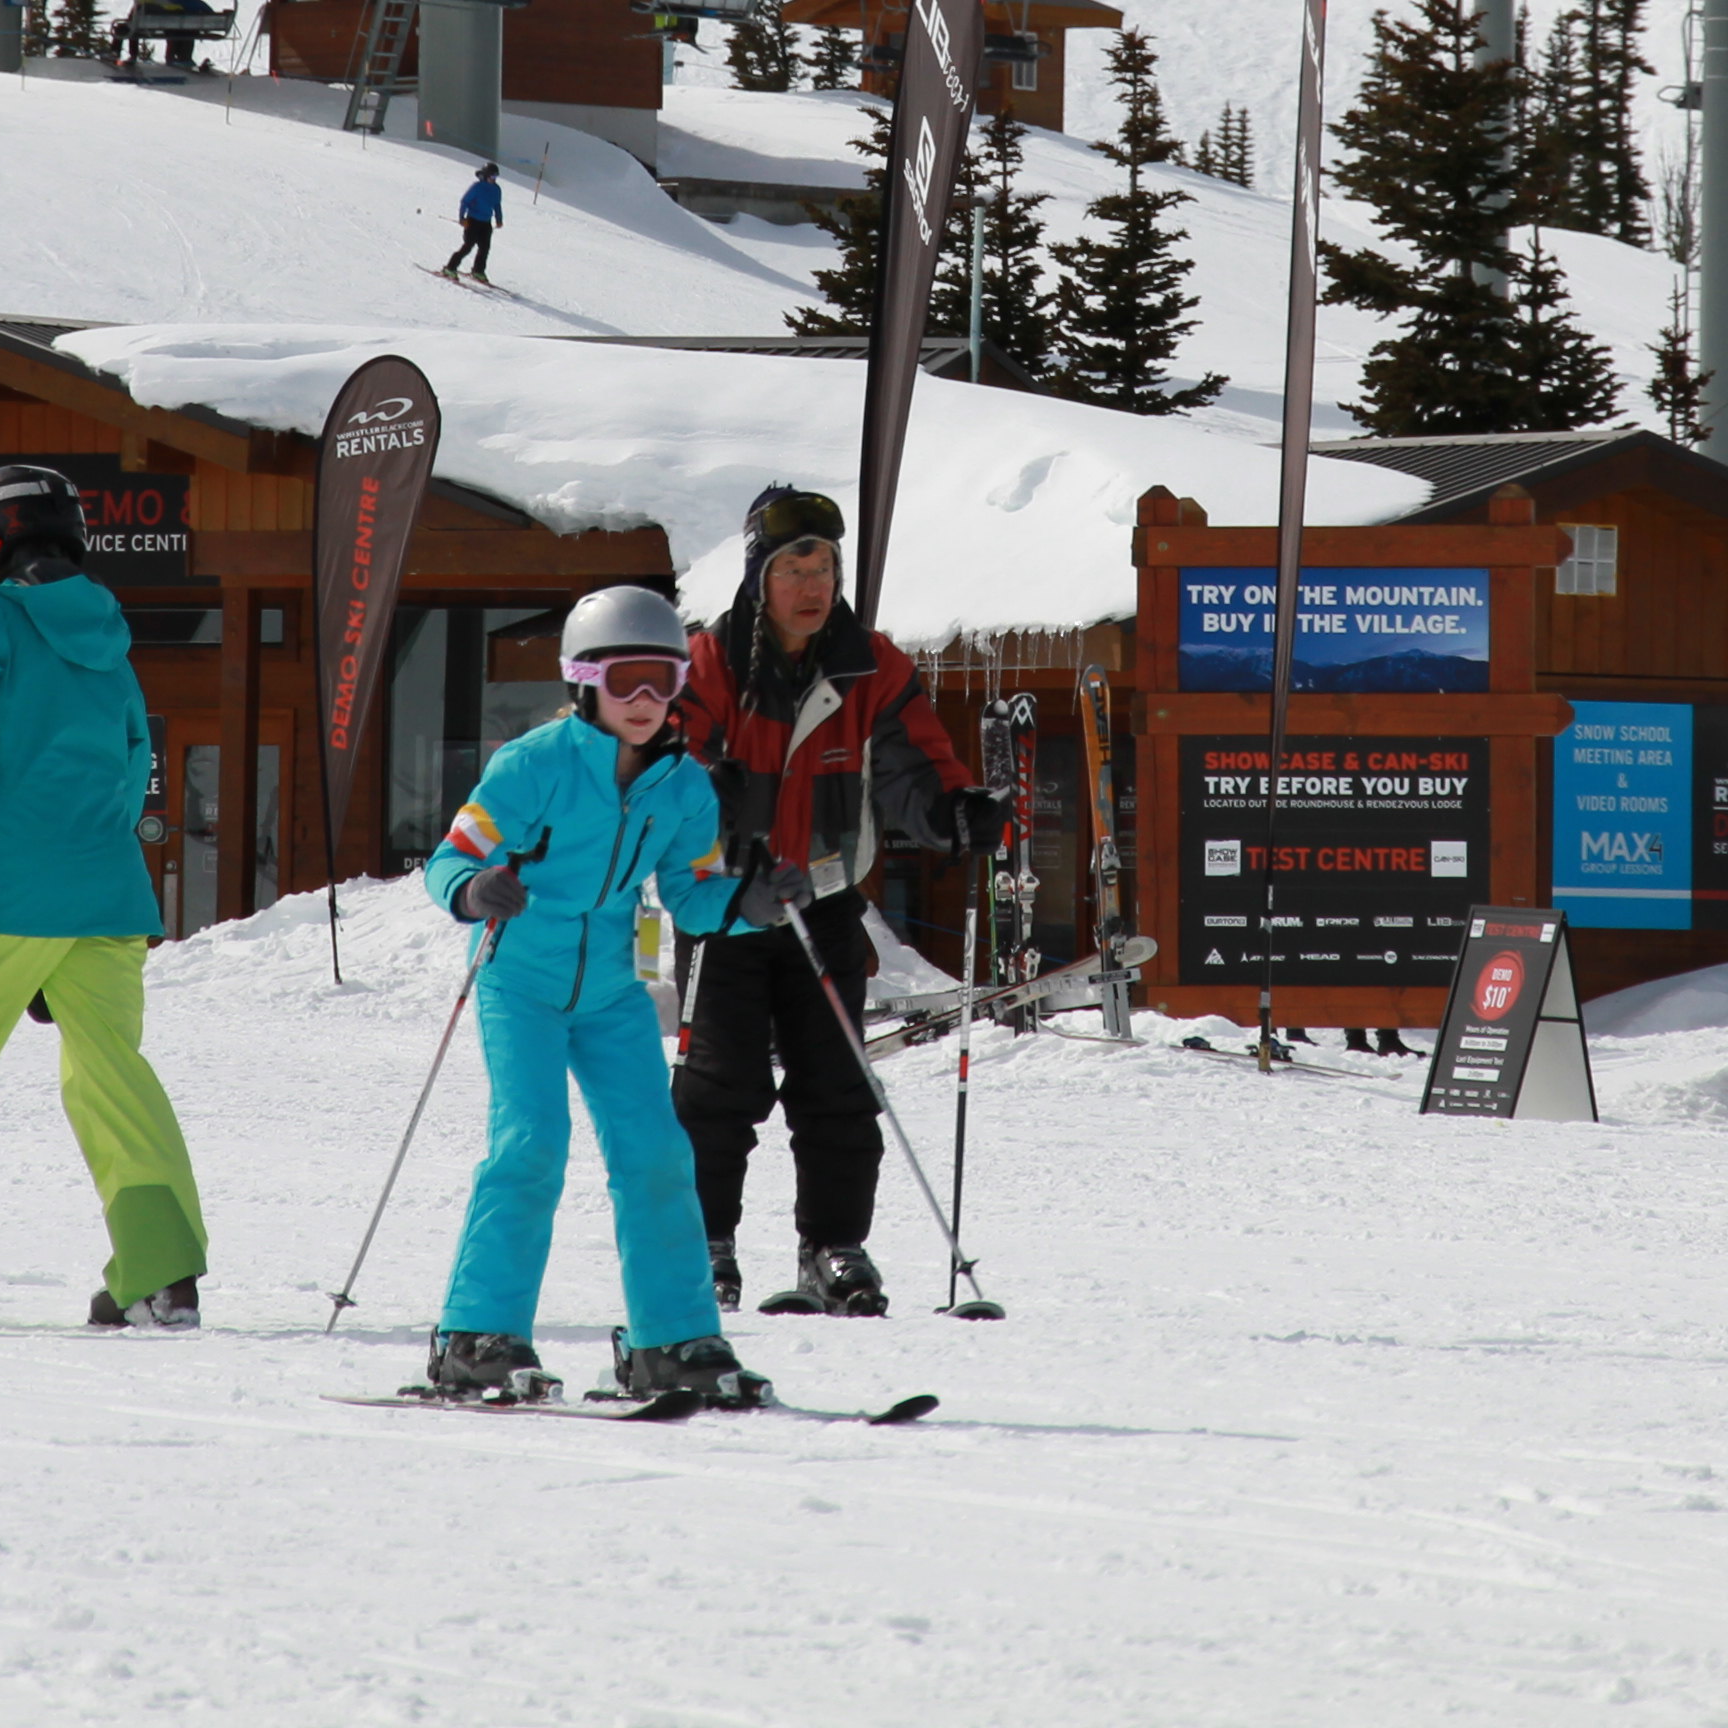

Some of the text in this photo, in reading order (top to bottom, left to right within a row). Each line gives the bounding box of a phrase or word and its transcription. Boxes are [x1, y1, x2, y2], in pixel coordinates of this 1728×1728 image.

[337, 426, 380, 440] WHISTLER
[337, 428, 425, 459] RENTALS
[1187, 585, 1236, 604] TRY
[1346, 586, 1484, 606] MOUNTAIN.
[331, 476, 381, 750] DEMO SKI CENTRE
[1203, 613, 1255, 633] BUY
[1297, 614, 1347, 633] THE
[1355, 615, 1467, 634] VILLAGE.
[1575, 724, 1672, 742] SNOW SCHOOL
[1344, 752, 1360, 771] &
[1368, 752, 1469, 771] CAN-SKI
[1574, 748, 1673, 766] MEETING AREA
[1204, 776, 1251, 795] TRY
[1361, 777, 1410, 795] YOU
[1418, 777, 1468, 796] BUY
[1617, 773, 1628, 788] &
[1204, 799, 1463, 810] LOCATED OUTDE ROUNDHOUSE & RENDEZVOUS LODGE
[1576, 795, 1669, 813] VIDEO ROOMS
[1246, 847, 1425, 871] TEST CENTRE
[1581, 863, 1663, 875] GROUP LESSONS
